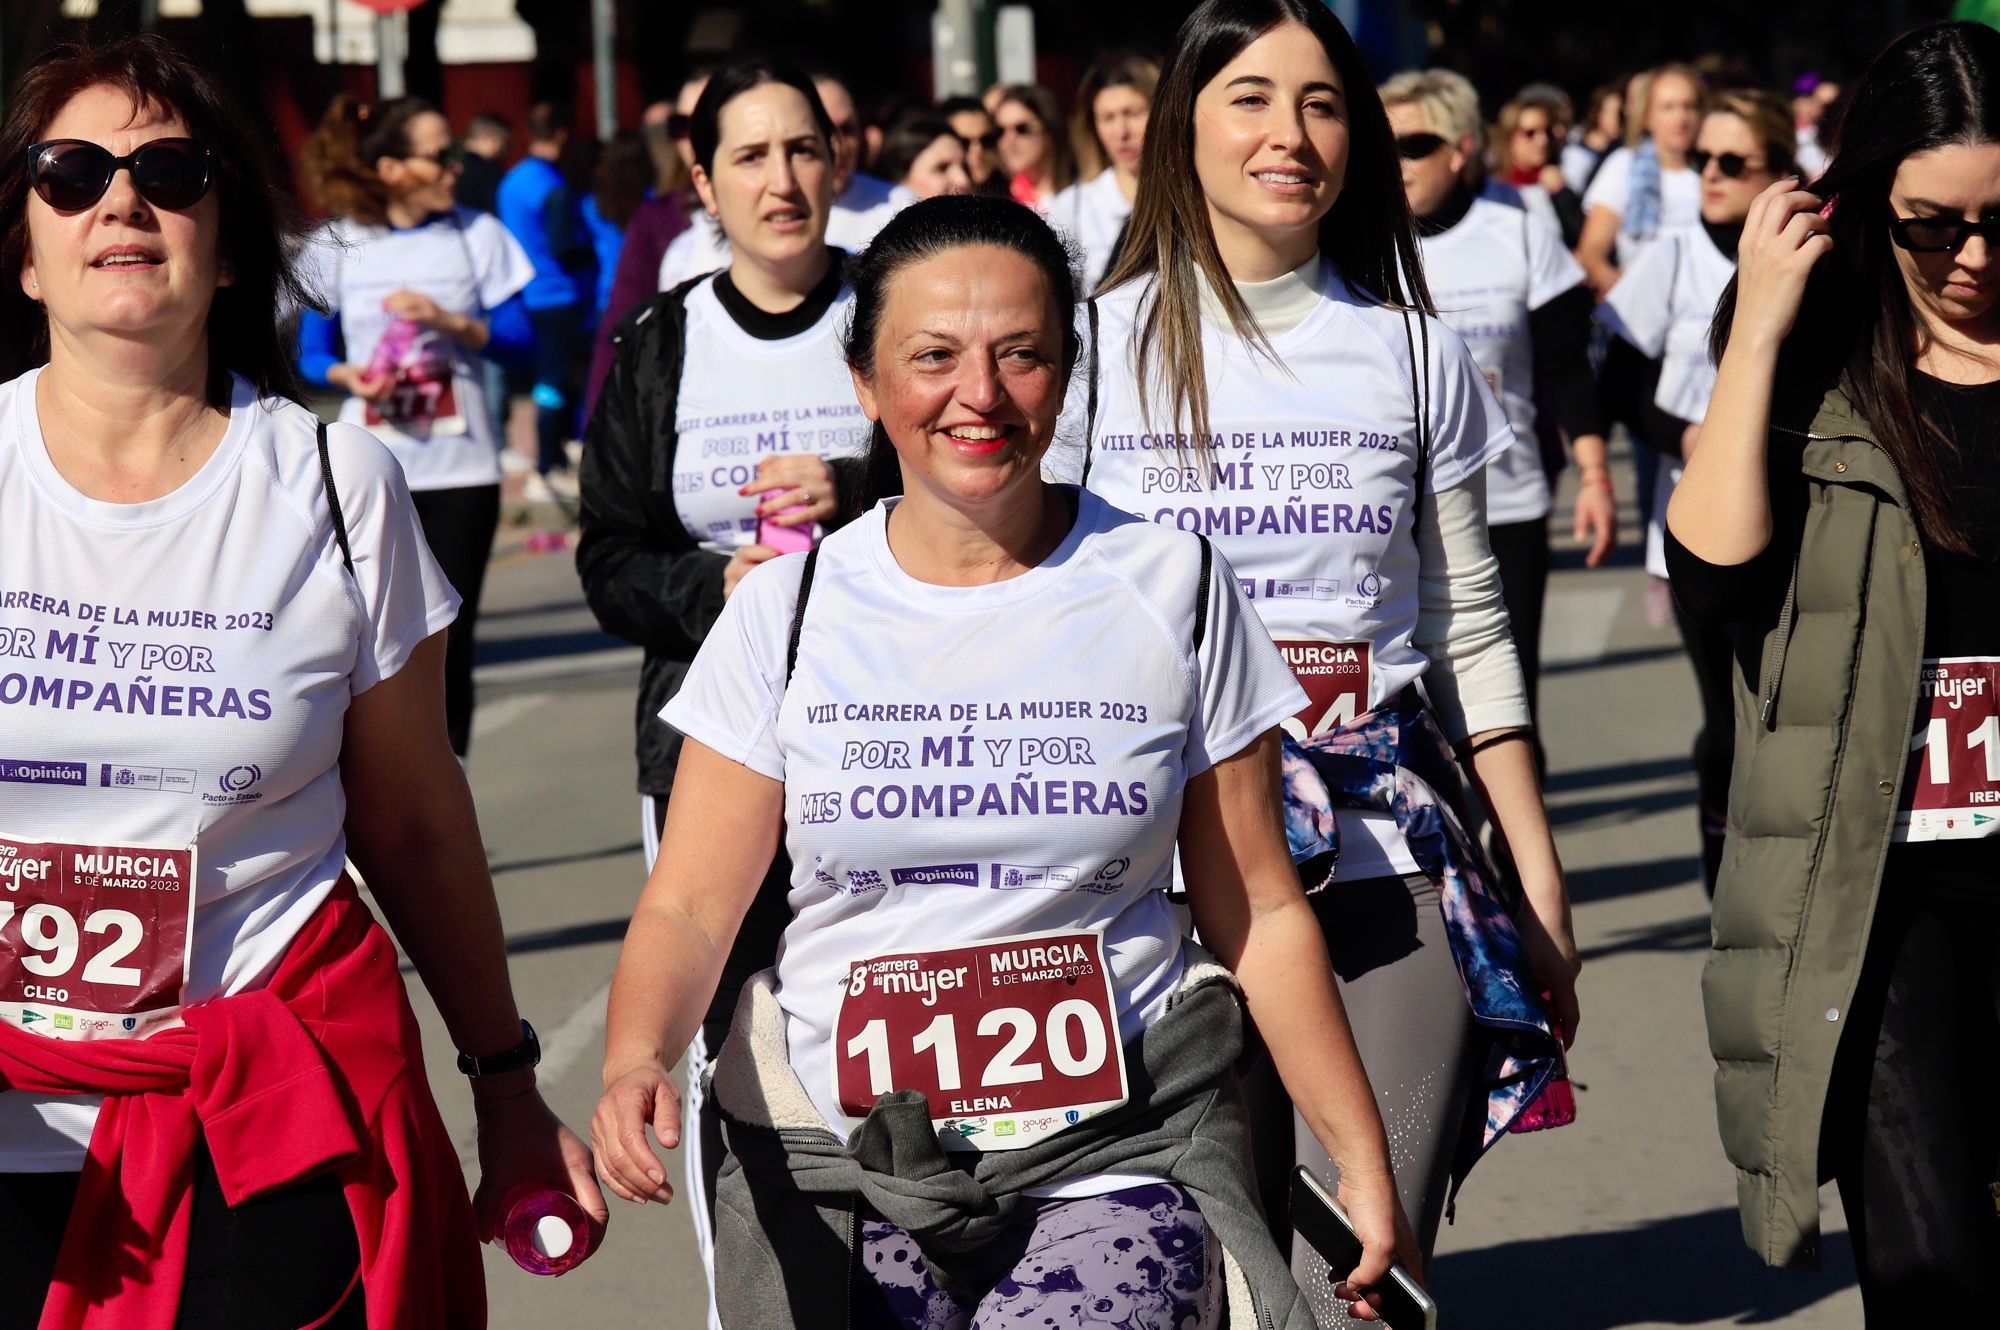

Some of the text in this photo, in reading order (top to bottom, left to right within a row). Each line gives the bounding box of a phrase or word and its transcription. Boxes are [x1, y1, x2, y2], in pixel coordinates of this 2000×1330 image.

[705, 413, 767, 428] CARRERA
[772, 410, 790, 422] DE
[795, 408, 812, 420] LA
[702, 436, 749, 458] POR
[756, 424, 791, 452] MÍ
[796, 431, 814, 449] Y
[1101, 431, 1399, 451] VIII CARRERA DE LA MUJER 2023
[1142, 452, 1353, 493] POR MÍ Y POR
[78, 602, 107, 622] DE
[113, 607, 139, 626] LA
[147, 610, 217, 630] MUJER
[225, 611, 274, 631] 2023
[45, 625, 100, 665] MÍ
[108, 641, 136, 668] Y
[141, 643, 216, 673] POR
[1296, 665, 1334, 675] MARZO
[1336, 664, 1361, 674] 2023
[1920, 677, 1986, 710] mujer
[806, 701, 1148, 724] VIII CARRERA DE LA MUJER 2023
[841, 724, 1097, 770] POR MÍ Y POR
[799, 772, 1149, 825] MIS COMPAÑERAS
[74, 853, 179, 878] MURCIA
[74, 876, 180, 892] 5 DE MARZO 2023
[0, 901, 144, 987] 92
[990, 943, 1090, 973] MURCIA
[872, 959, 919, 974] carrera
[992, 964, 1094, 986] 5 DE MARZO 2023
[23, 985, 69, 1002] CLEO
[883, 966, 968, 1007] mujer
[847, 999, 1107, 1096] 1120
[950, 1096, 1012, 1113] ELENA
